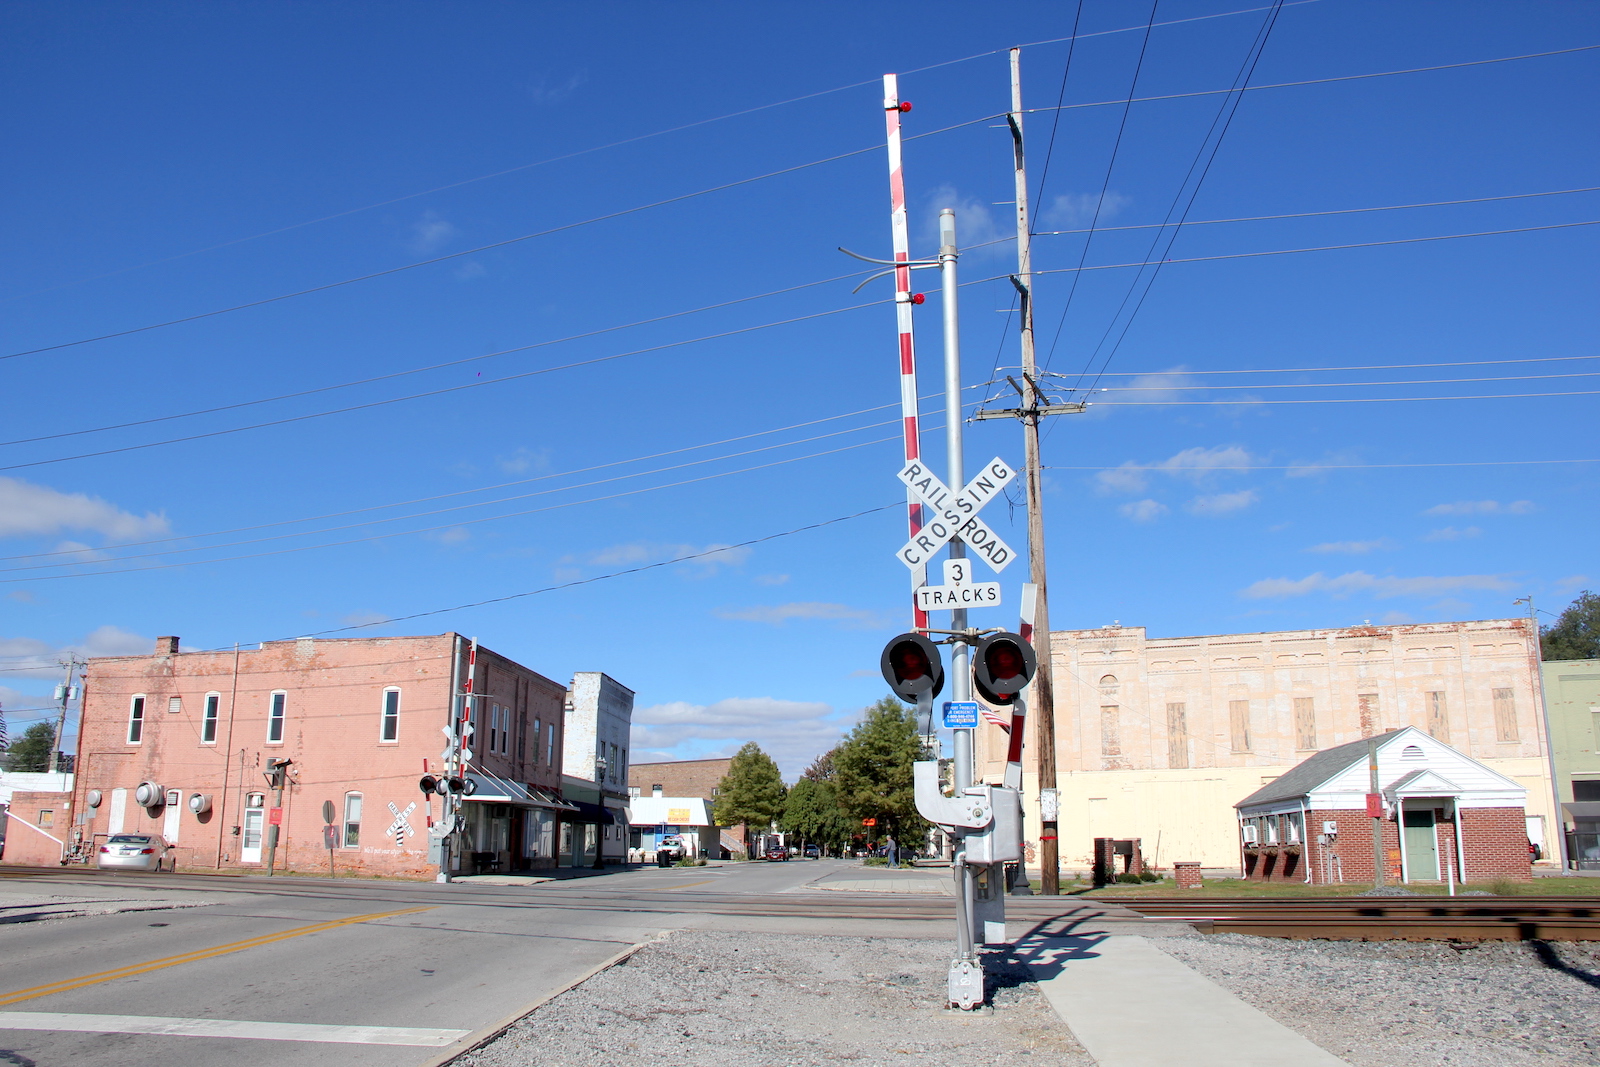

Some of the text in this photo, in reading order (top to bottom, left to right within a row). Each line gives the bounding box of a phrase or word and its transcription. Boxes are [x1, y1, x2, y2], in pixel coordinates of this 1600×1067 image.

[904, 464, 1008, 564] RAIL ROAD
[904, 464, 1008, 564] CROSSING
[952, 564, 963, 581] 3
[921, 587, 996, 605] TRACKS
[389, 805, 413, 833] EXPRESS
